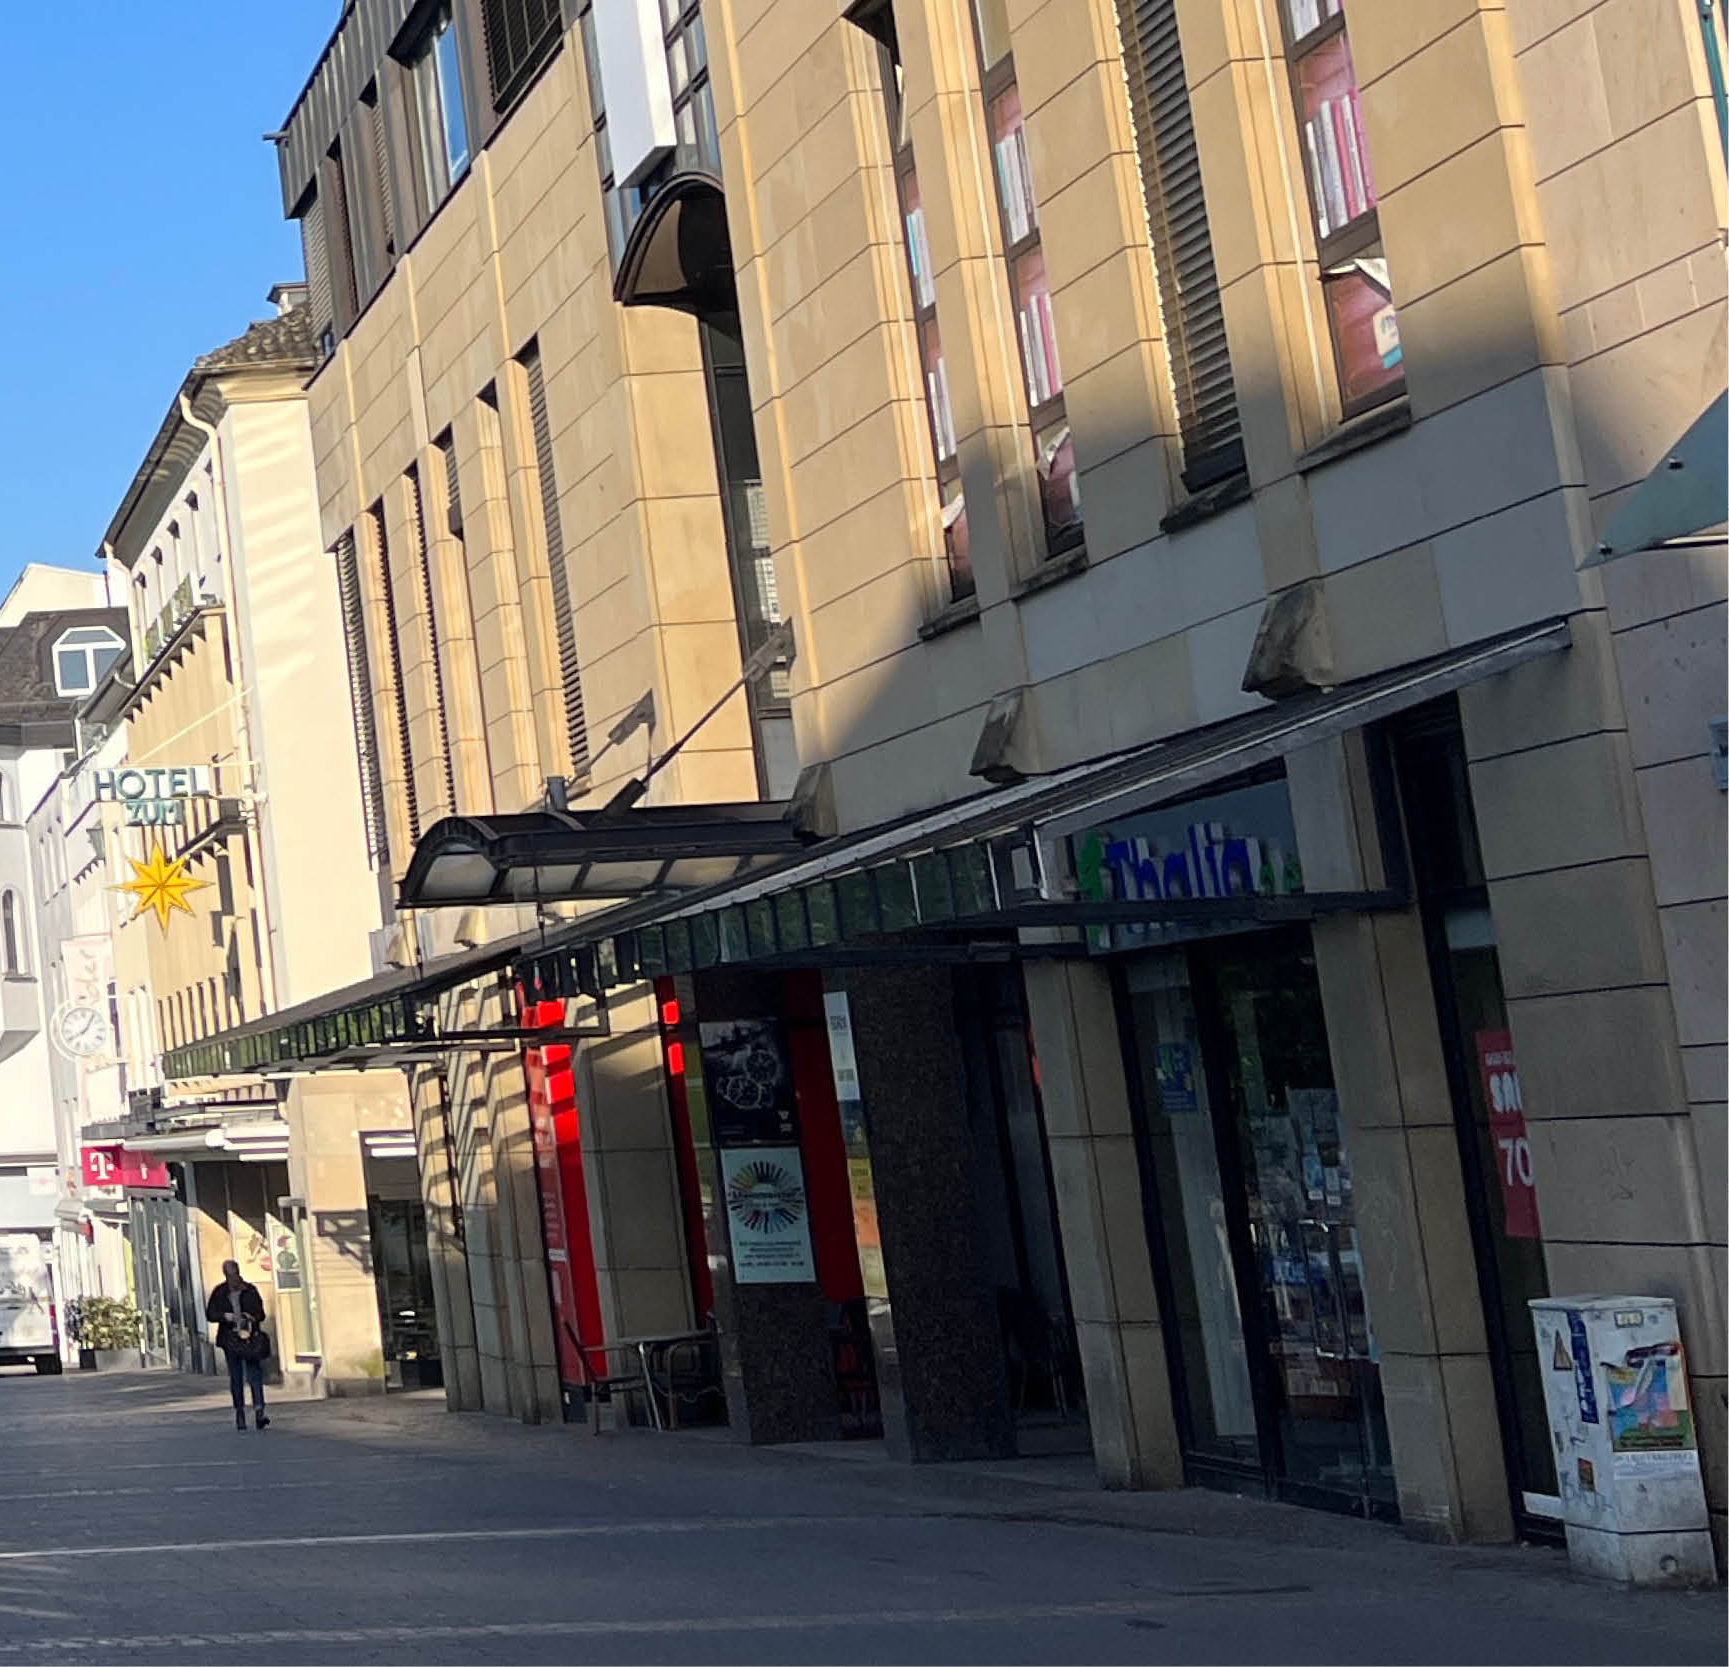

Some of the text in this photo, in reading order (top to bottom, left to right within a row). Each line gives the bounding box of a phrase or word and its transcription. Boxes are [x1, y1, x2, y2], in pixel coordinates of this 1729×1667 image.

[94, 767, 210, 800] HOTEL
[125, 801, 185, 826] ZUM
[1104, 822, 1261, 901] Thalia
[89, 1151, 115, 1181] T
[1498, 1137, 1534, 1188] 70
